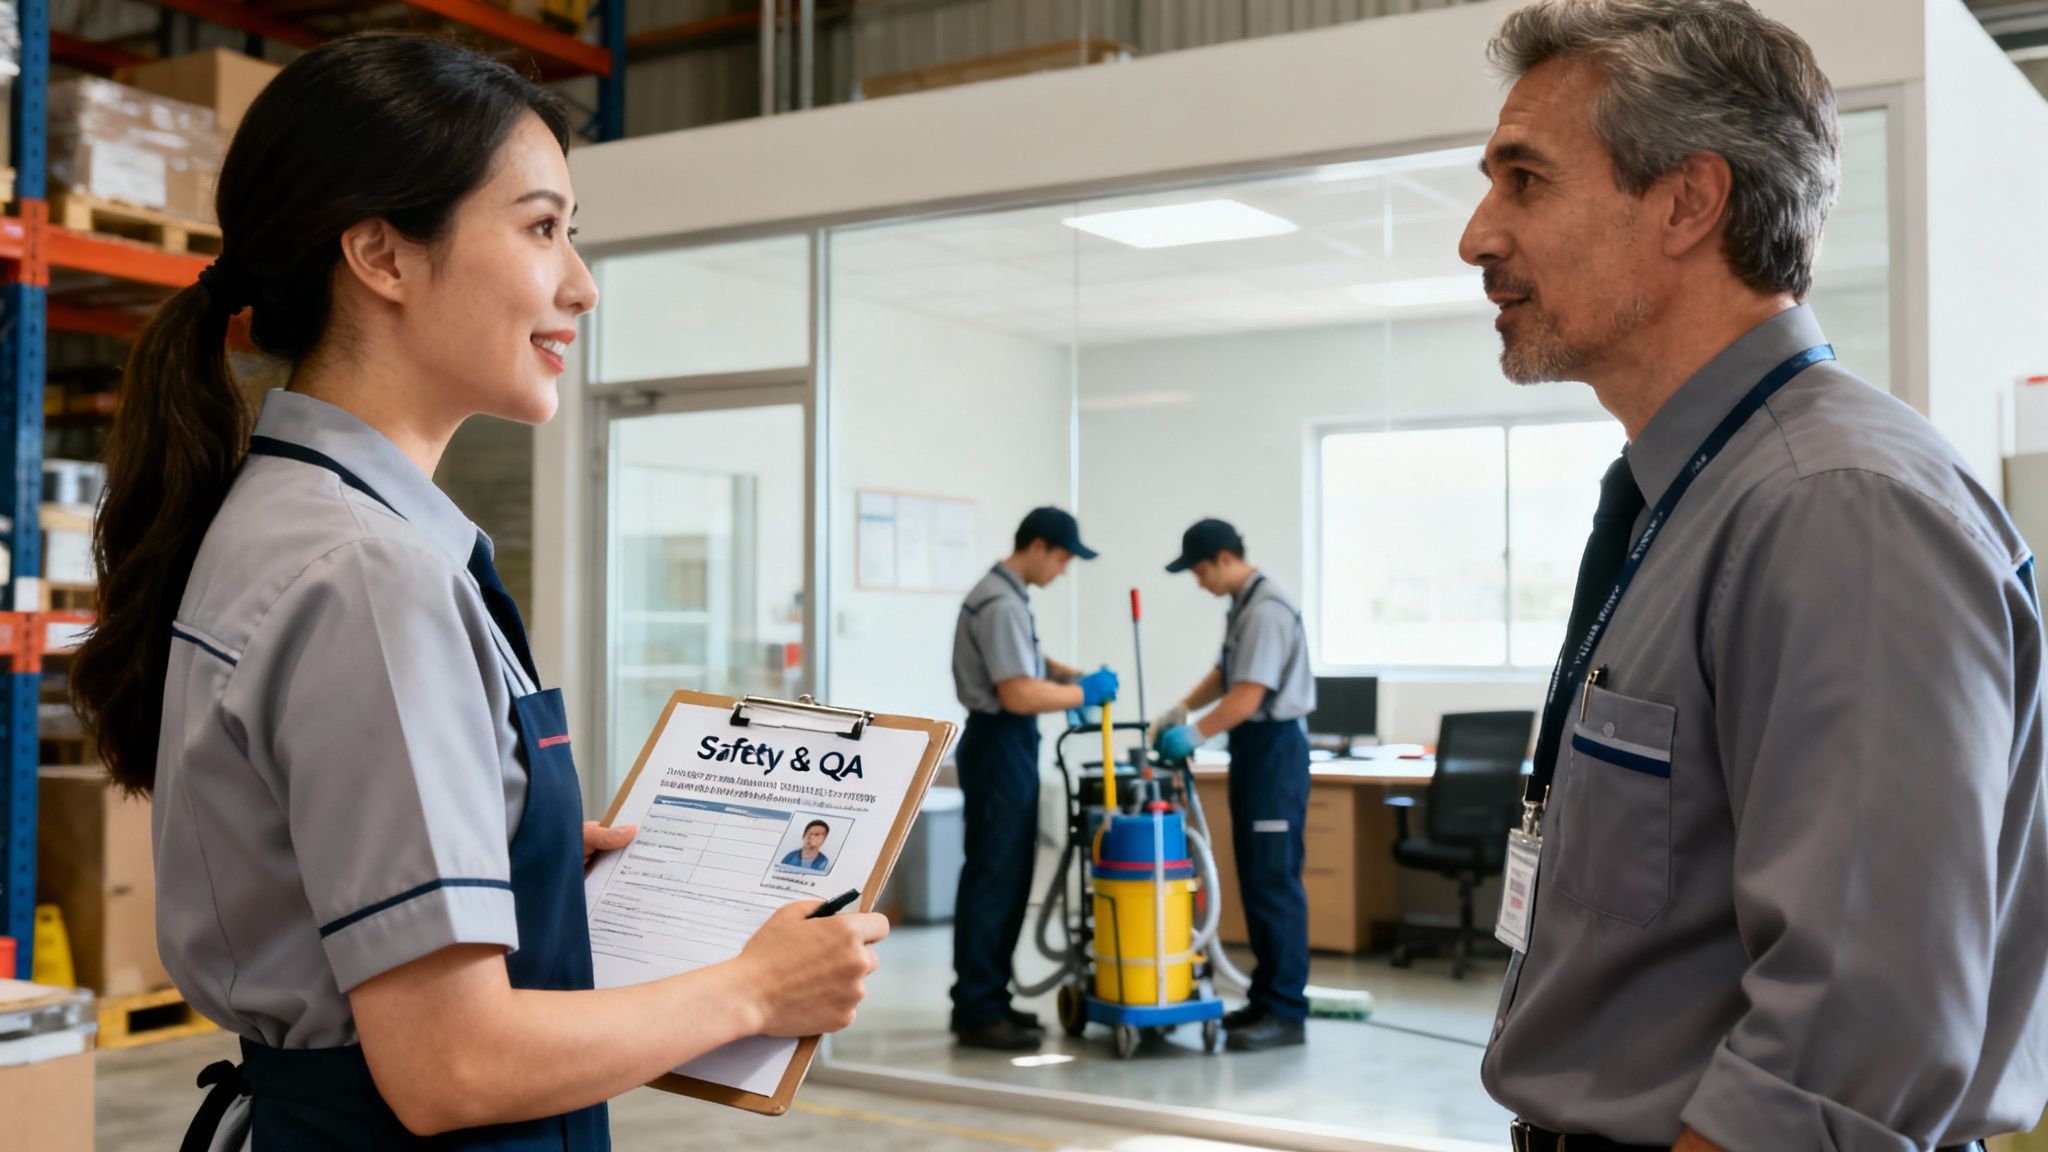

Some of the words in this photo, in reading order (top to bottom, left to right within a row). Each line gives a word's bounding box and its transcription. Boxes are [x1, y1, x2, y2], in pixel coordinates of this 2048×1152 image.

[697, 735, 784, 775] Safety
[790, 746, 811, 772] &
[819, 751, 864, 782] QA
